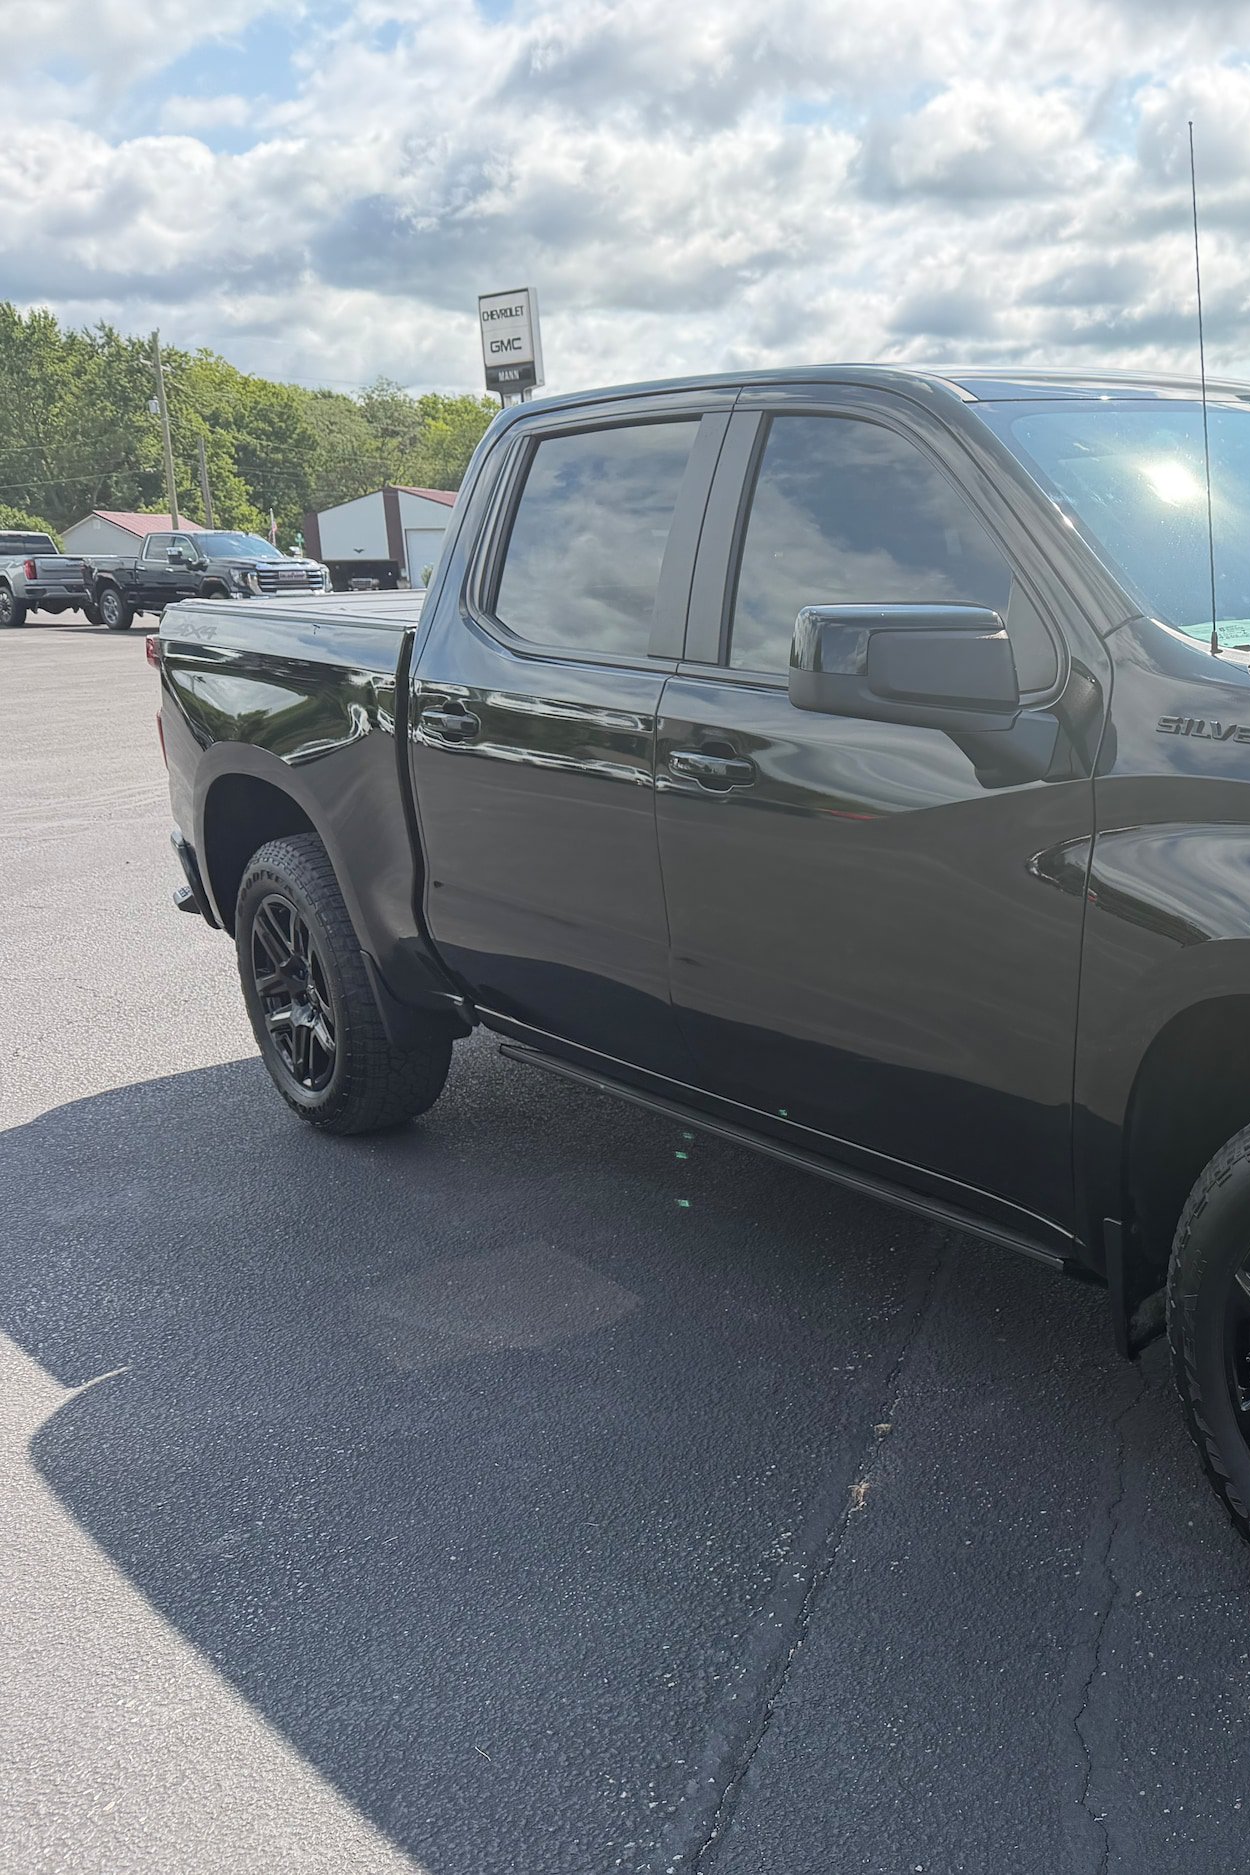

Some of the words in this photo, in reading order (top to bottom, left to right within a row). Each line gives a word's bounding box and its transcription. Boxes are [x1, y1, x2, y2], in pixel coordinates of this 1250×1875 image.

[482, 305, 523, 321] CHEVROLET
[490, 337, 522, 353] GMC
[498, 370, 520, 382] MANN
